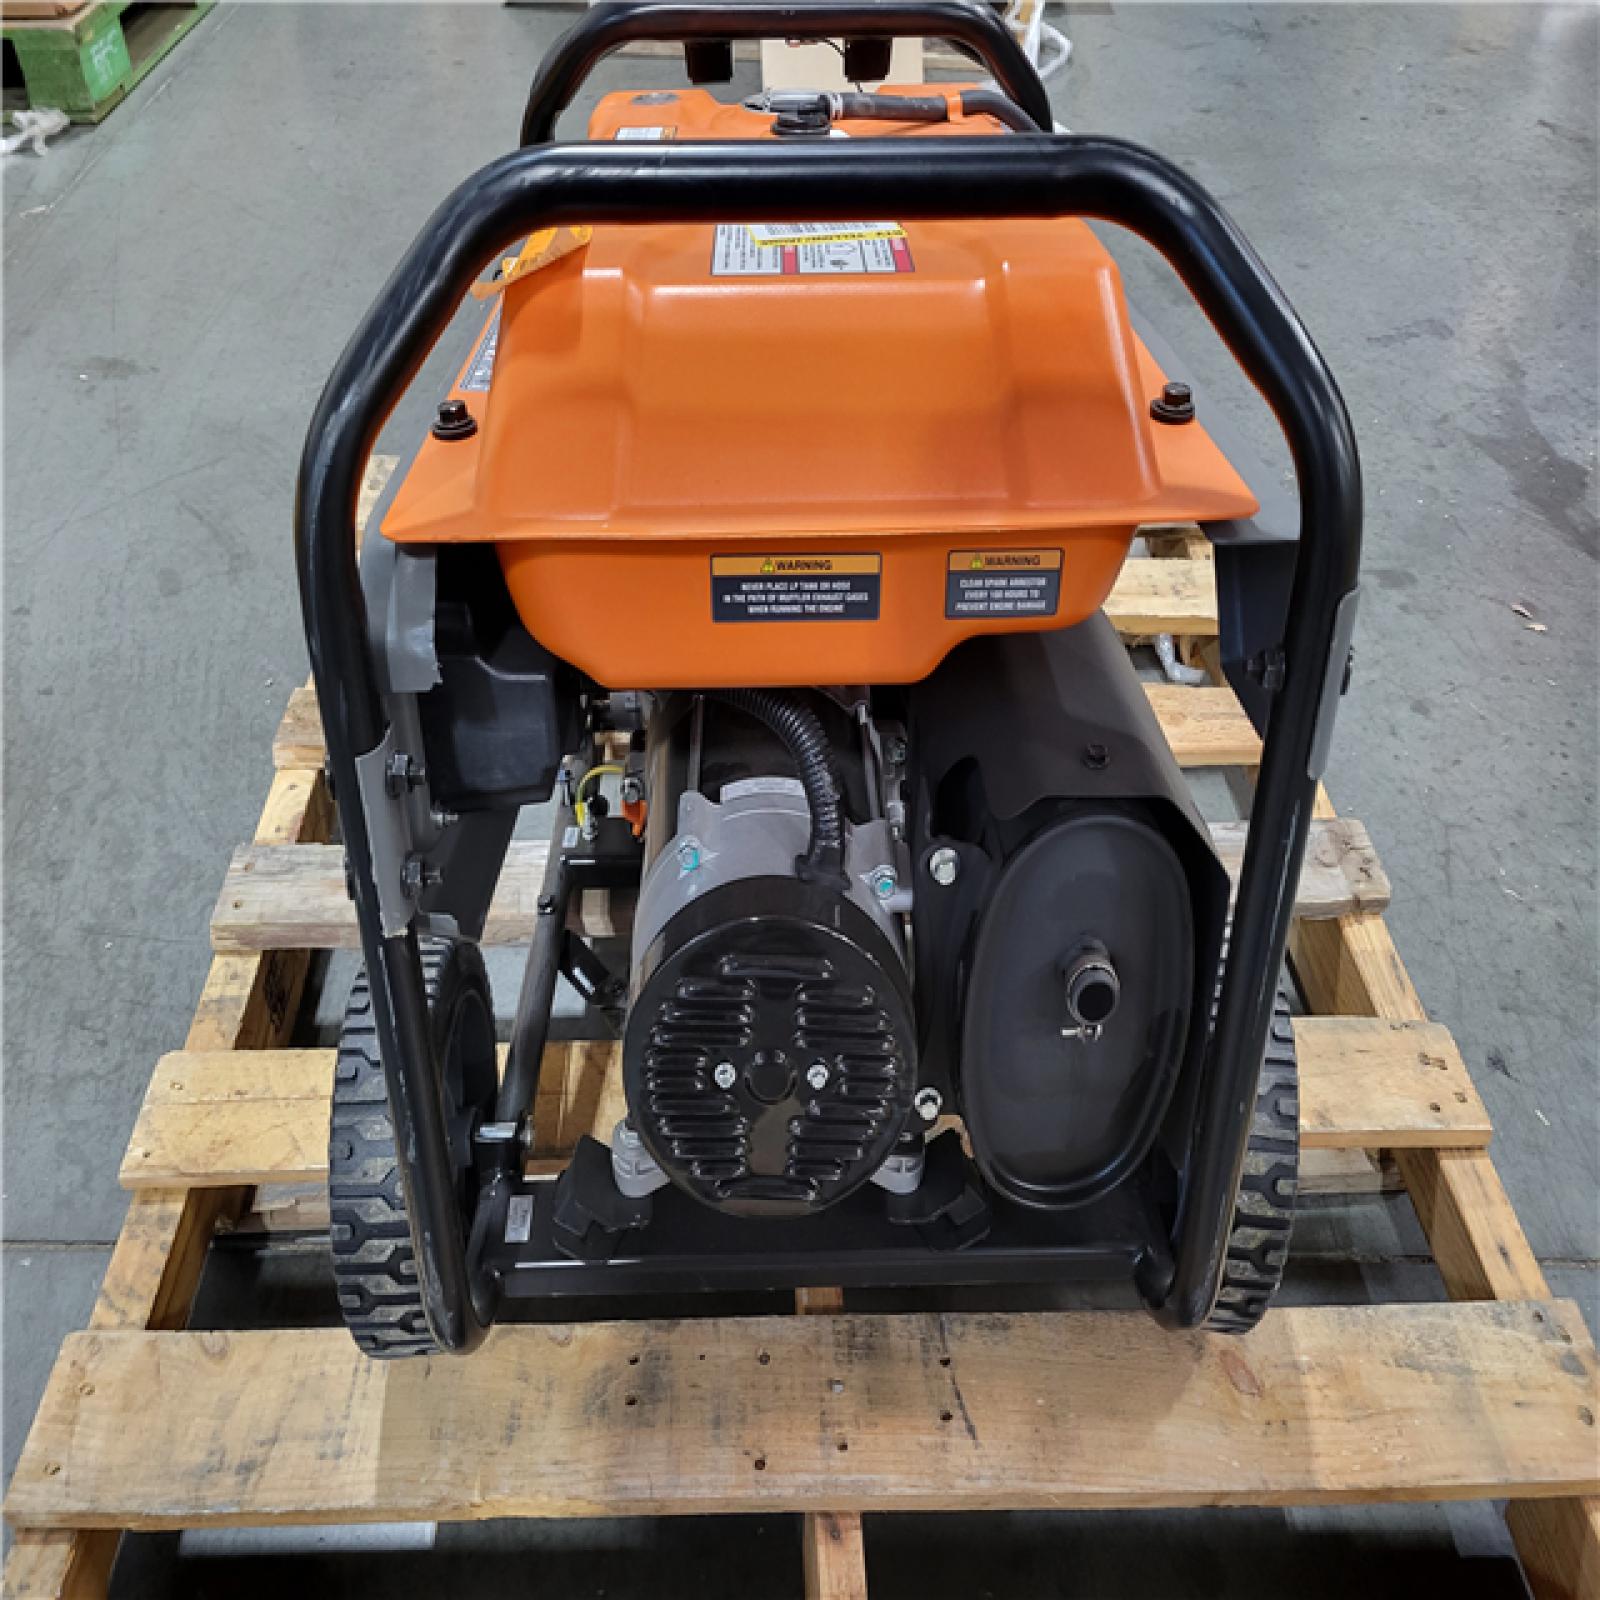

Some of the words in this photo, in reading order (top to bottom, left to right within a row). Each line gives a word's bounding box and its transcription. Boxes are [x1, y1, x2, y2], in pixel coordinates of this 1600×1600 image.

[775, 559, 832, 571] WARNING
[984, 554, 1041, 566] WARNING
[764, 582, 788, 591] PLACE
